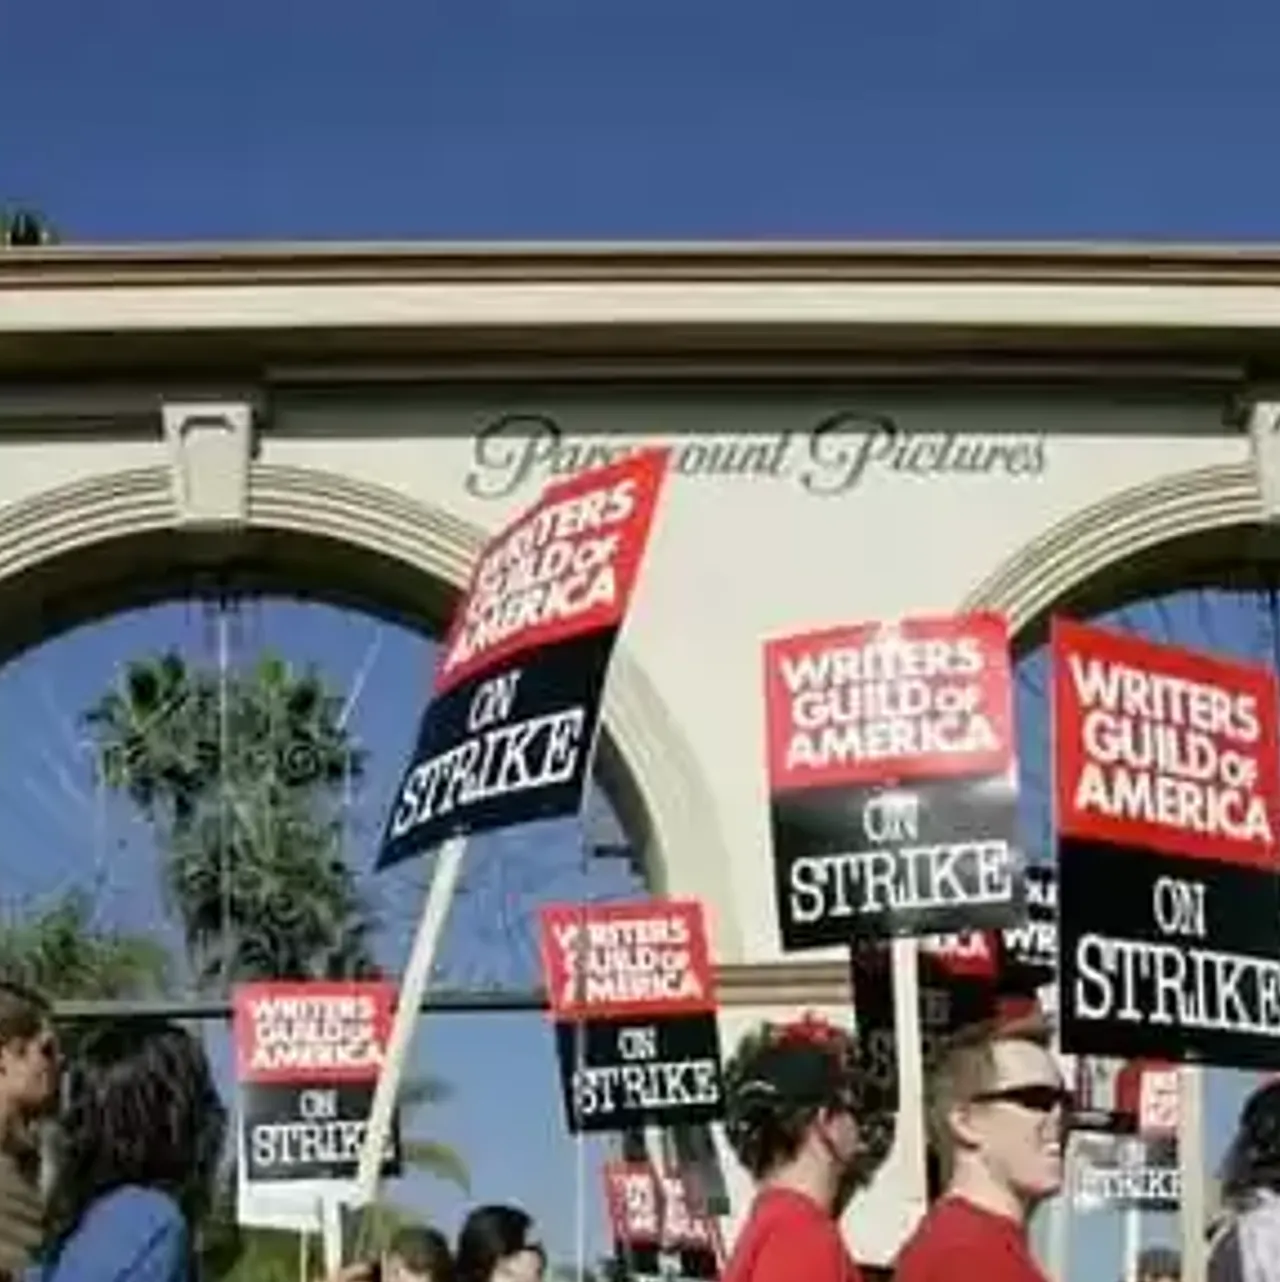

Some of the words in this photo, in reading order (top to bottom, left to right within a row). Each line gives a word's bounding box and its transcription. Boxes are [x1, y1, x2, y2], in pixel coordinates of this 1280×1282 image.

[466, 414, 792, 497] Paraount
[800, 411, 1047, 497] Pictures
[443, 565, 616, 675] AMERICA
[781, 637, 984, 694] WRITERS
[467, 670, 522, 733] ON
[792, 680, 931, 729] GUILD
[934, 684, 982, 713] OF
[1068, 651, 1262, 743] WRITERS
[390, 707, 585, 838] STRIKE
[786, 714, 1002, 771] AMERICA
[1082, 709, 1218, 780] GUILD
[1219, 750, 1259, 789] OF
[862, 791, 919, 844] ON
[1074, 762, 1274, 846] AMERICA
[789, 838, 1013, 922] STRIKE
[1152, 875, 1208, 938] ON
[249, 1041, 388, 1071] AMERICA
[618, 1025, 656, 1060] ON
[298, 1088, 338, 1118] ON
[573, 1058, 720, 1114] STRIKE
[251, 1119, 395, 1167] STRIK
